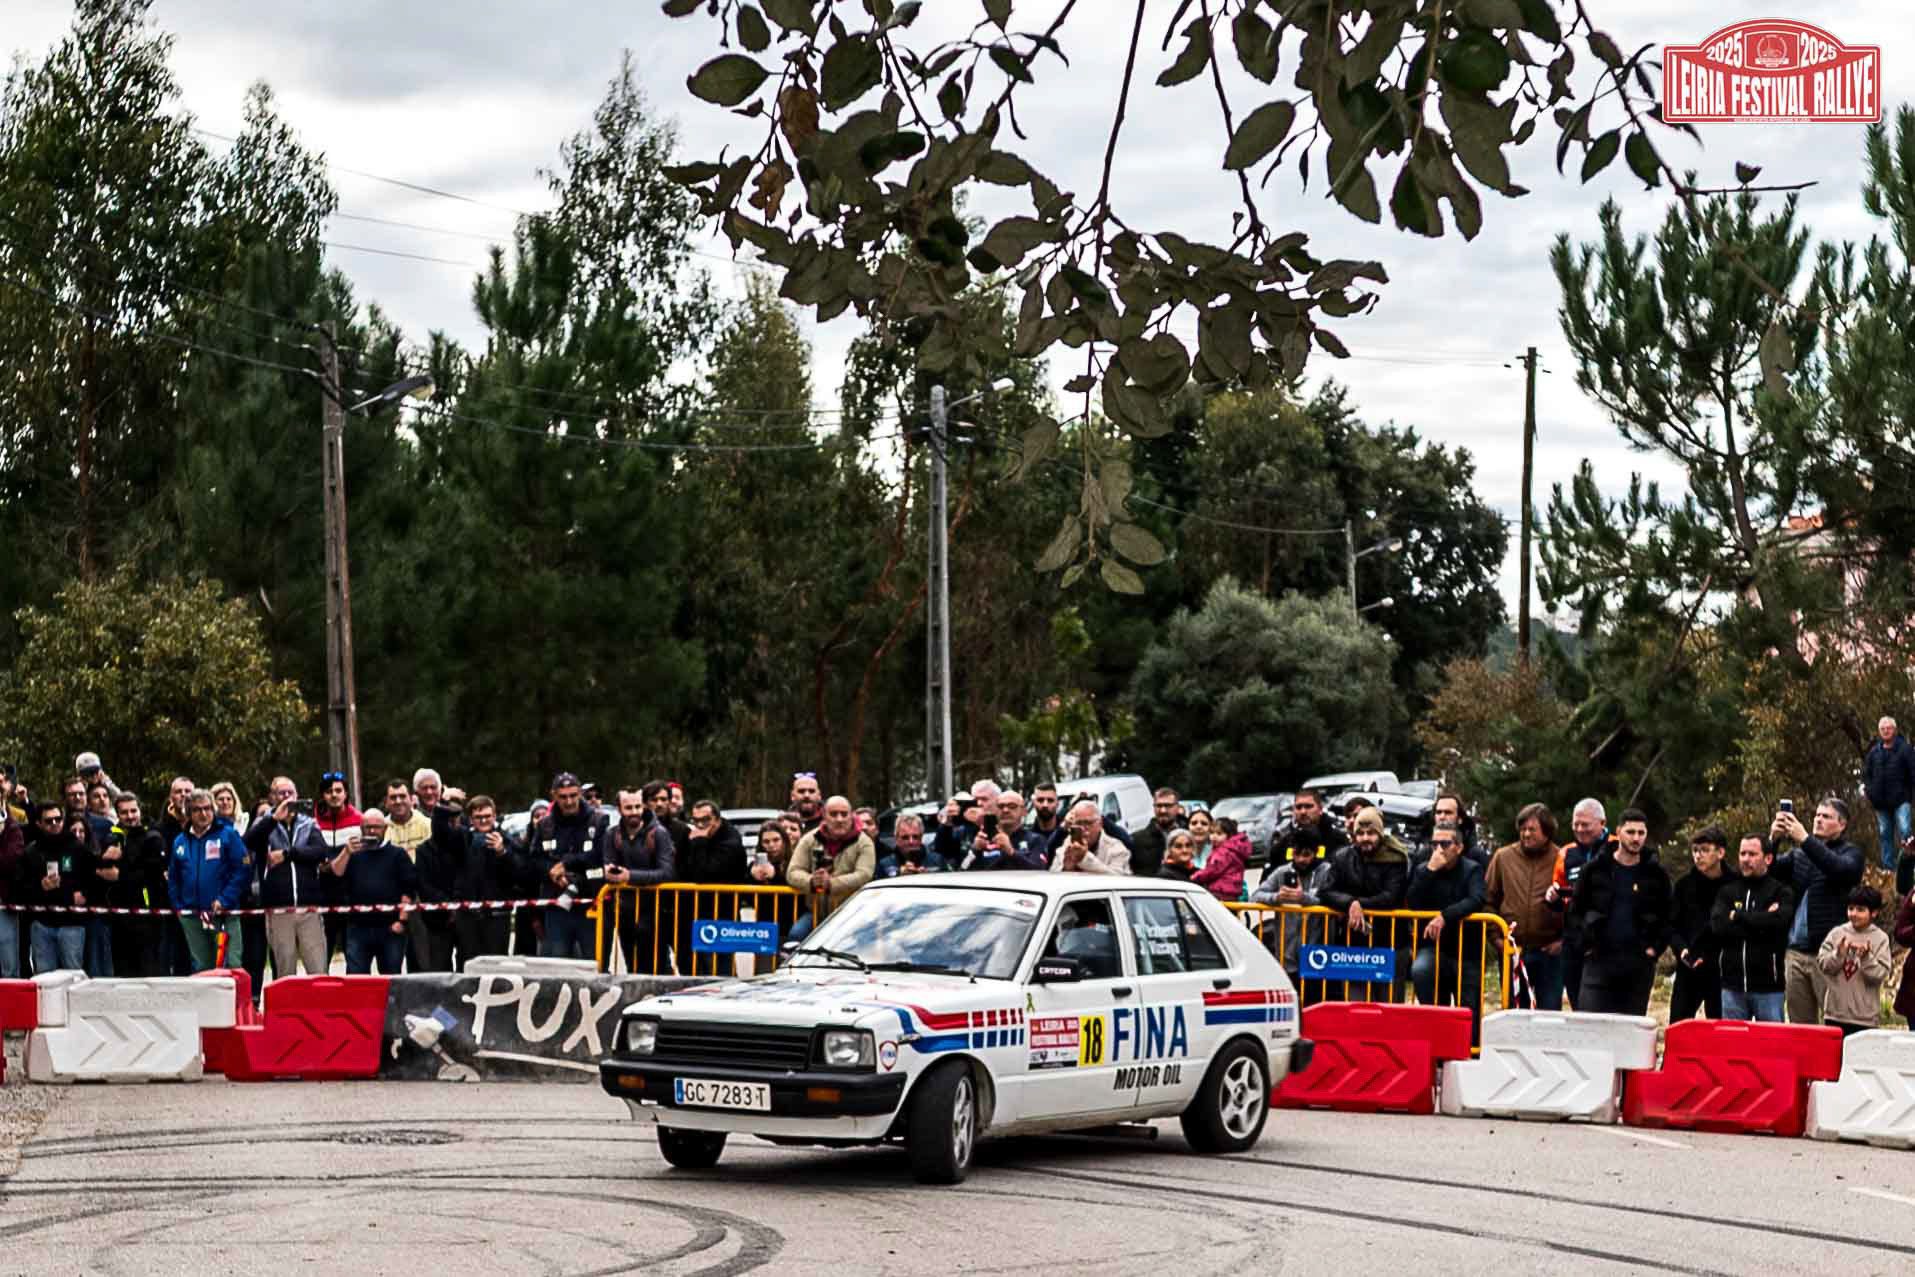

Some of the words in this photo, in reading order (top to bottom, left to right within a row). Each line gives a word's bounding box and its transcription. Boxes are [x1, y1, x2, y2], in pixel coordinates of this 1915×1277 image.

[720, 927, 770, 938] Oliveiras
[1331, 952, 1386, 964] Oliveiras
[461, 974, 623, 1056] PUX
[1083, 1017, 1103, 1064] 18
[1112, 1005, 1188, 1061] FINA
[1113, 1065, 1160, 1090] MOTOR
[1162, 1064, 1181, 1086] OIL
[685, 1082, 705, 1102] GC
